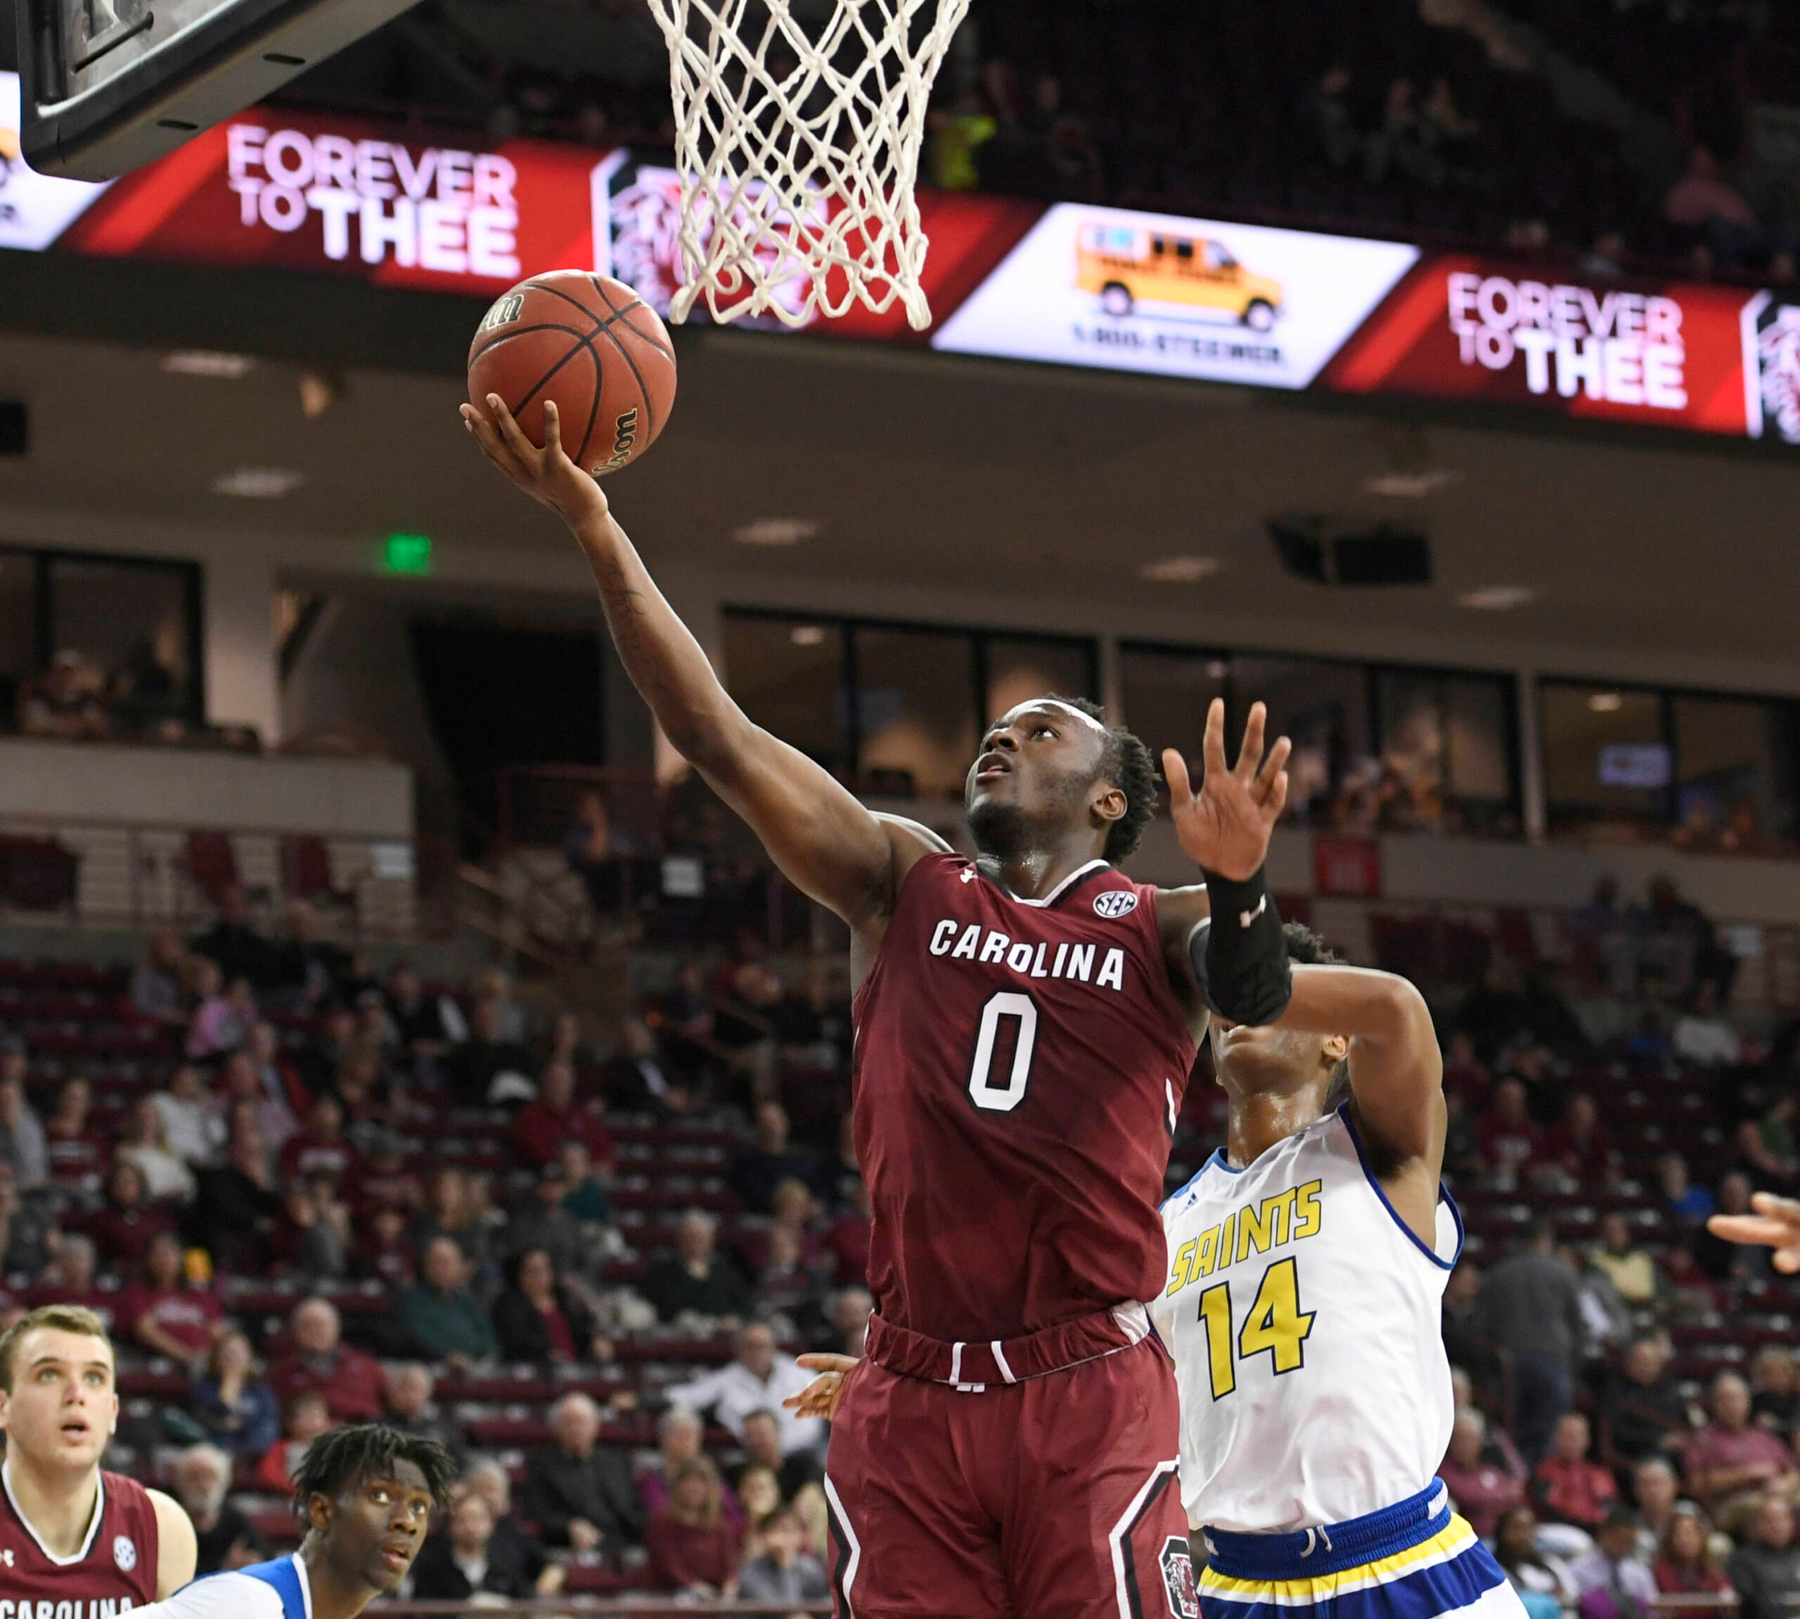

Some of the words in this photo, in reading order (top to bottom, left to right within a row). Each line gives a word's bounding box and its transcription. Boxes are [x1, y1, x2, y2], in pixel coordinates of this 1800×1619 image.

[227, 124, 518, 209] FOREVER
[228, 177, 307, 232] TO
[305, 185, 522, 279] THEE
[1448, 272, 1684, 346] FOREVER
[1450, 320, 1515, 370] TO
[1513, 328, 1688, 409] THEE
[1096, 892, 1136, 916] SEC
[929, 918, 1125, 991] CAROLINA
[967, 991, 1038, 1112] 0
[1166, 1178, 1322, 1297] SAINTS
[1198, 1255, 1317, 1401] 14
